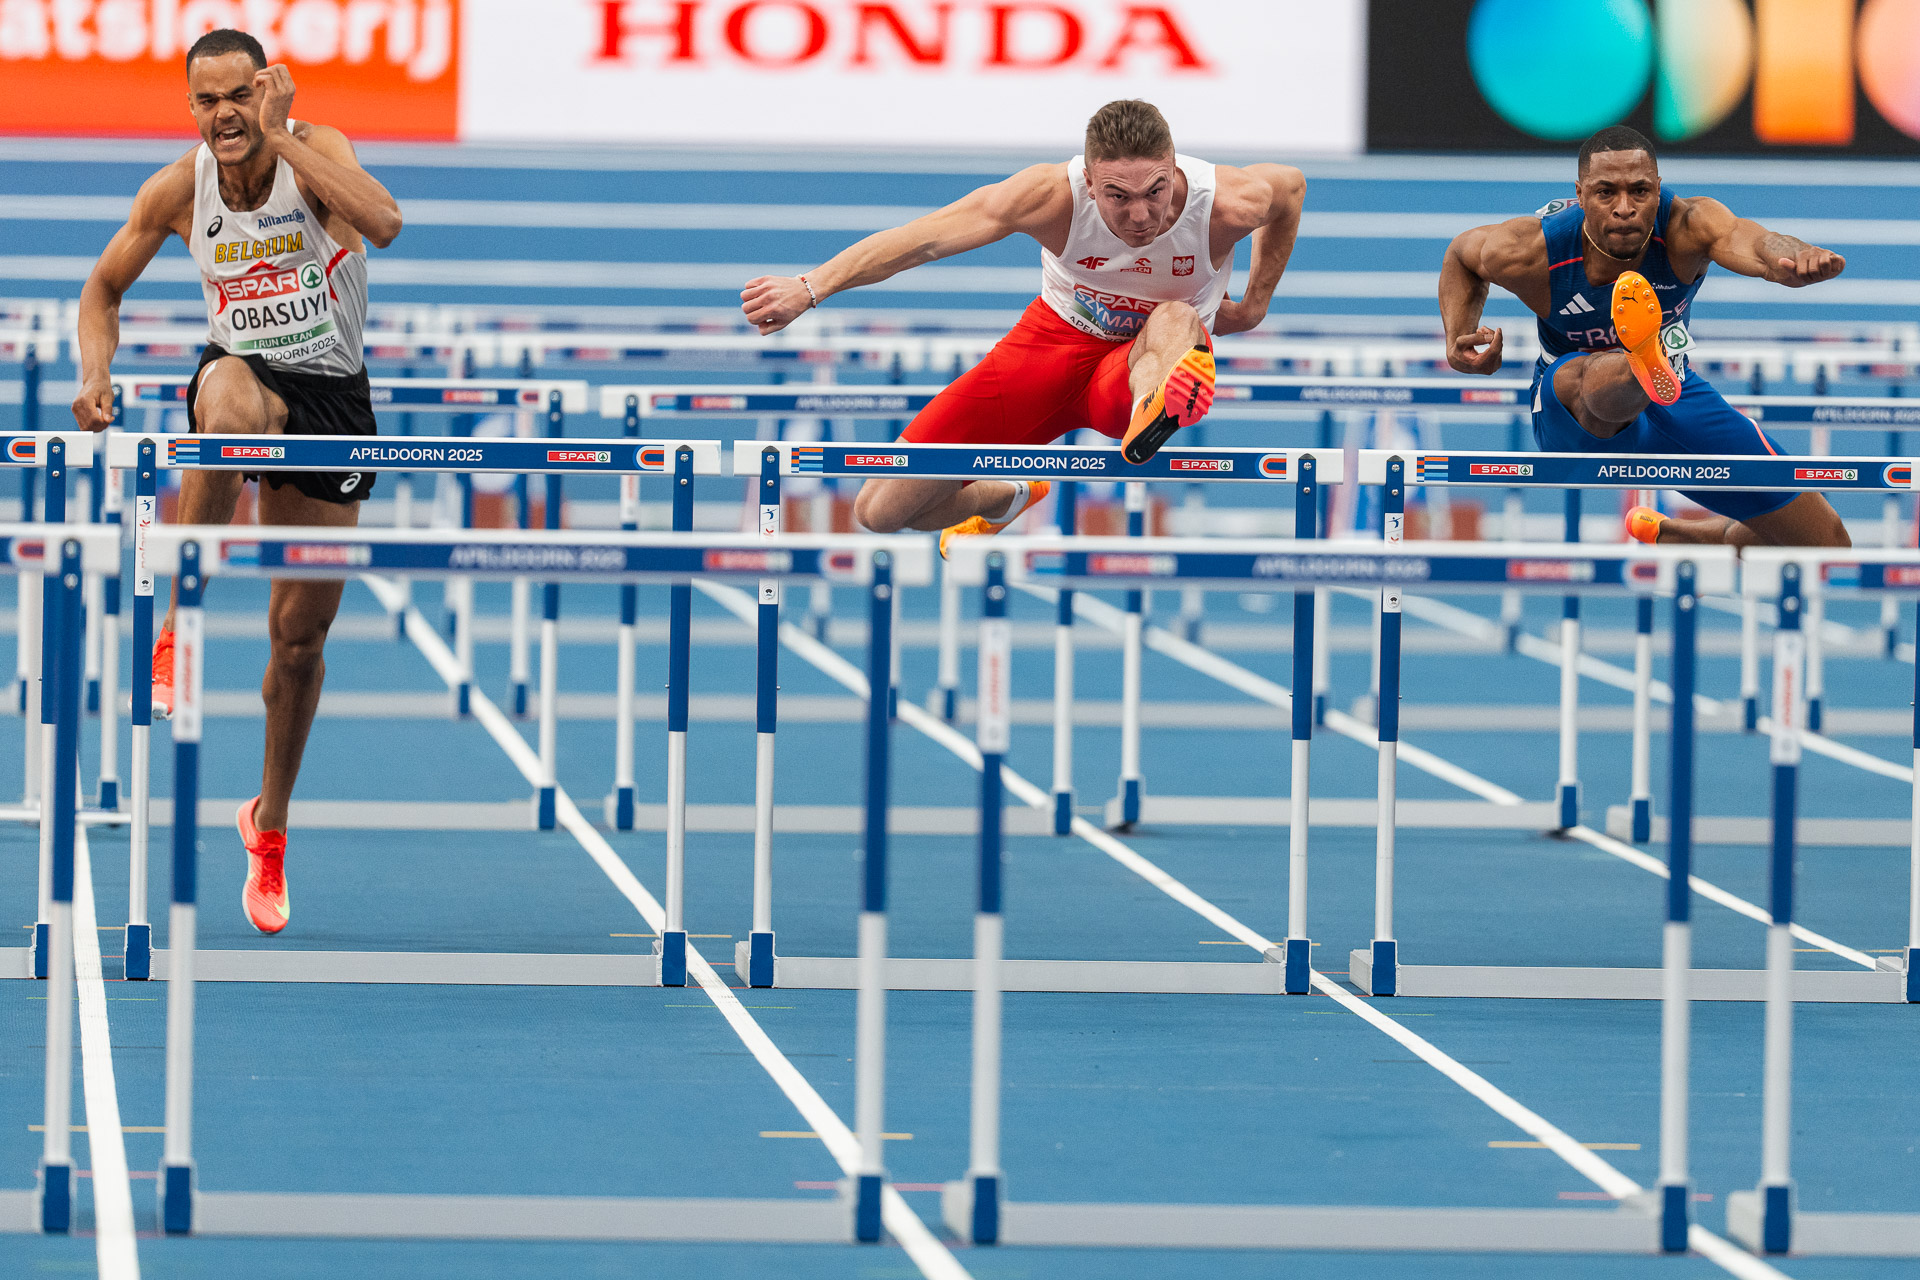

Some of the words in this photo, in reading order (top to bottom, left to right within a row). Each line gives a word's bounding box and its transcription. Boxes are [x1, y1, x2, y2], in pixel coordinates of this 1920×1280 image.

[588, 0, 1213, 69] HONDA
[257, 213, 294, 230] Allianz
[215, 231, 304, 263] BELGIUM
[1077, 256, 1109, 270] 4F
[225, 272, 298, 299] SPAR
[232, 291, 328, 331] OBASUYI
[1076, 292, 1148, 328] SZYMAN
[259, 338, 280, 348] RUN
[281, 331, 313, 345] CLEAN
[265, 346, 309, 361] DOORN
[311, 335, 337, 354] 2025
[232, 448, 269, 457] SPAR
[350, 448, 445, 461] APELDOORN
[448, 448, 483, 462] 2025
[559, 452, 596, 461] SPAR
[856, 456, 893, 465] SPAR
[973, 456, 1067, 469] APELDOORN
[1071, 457, 1106, 470] 2025
[1181, 460, 1218, 469] SPAR
[1481, 465, 1518, 474] SPAR
[1598, 465, 1692, 479] APELDOORN
[1695, 466, 1730, 480] 2025
[1806, 470, 1843, 479] SPAR
